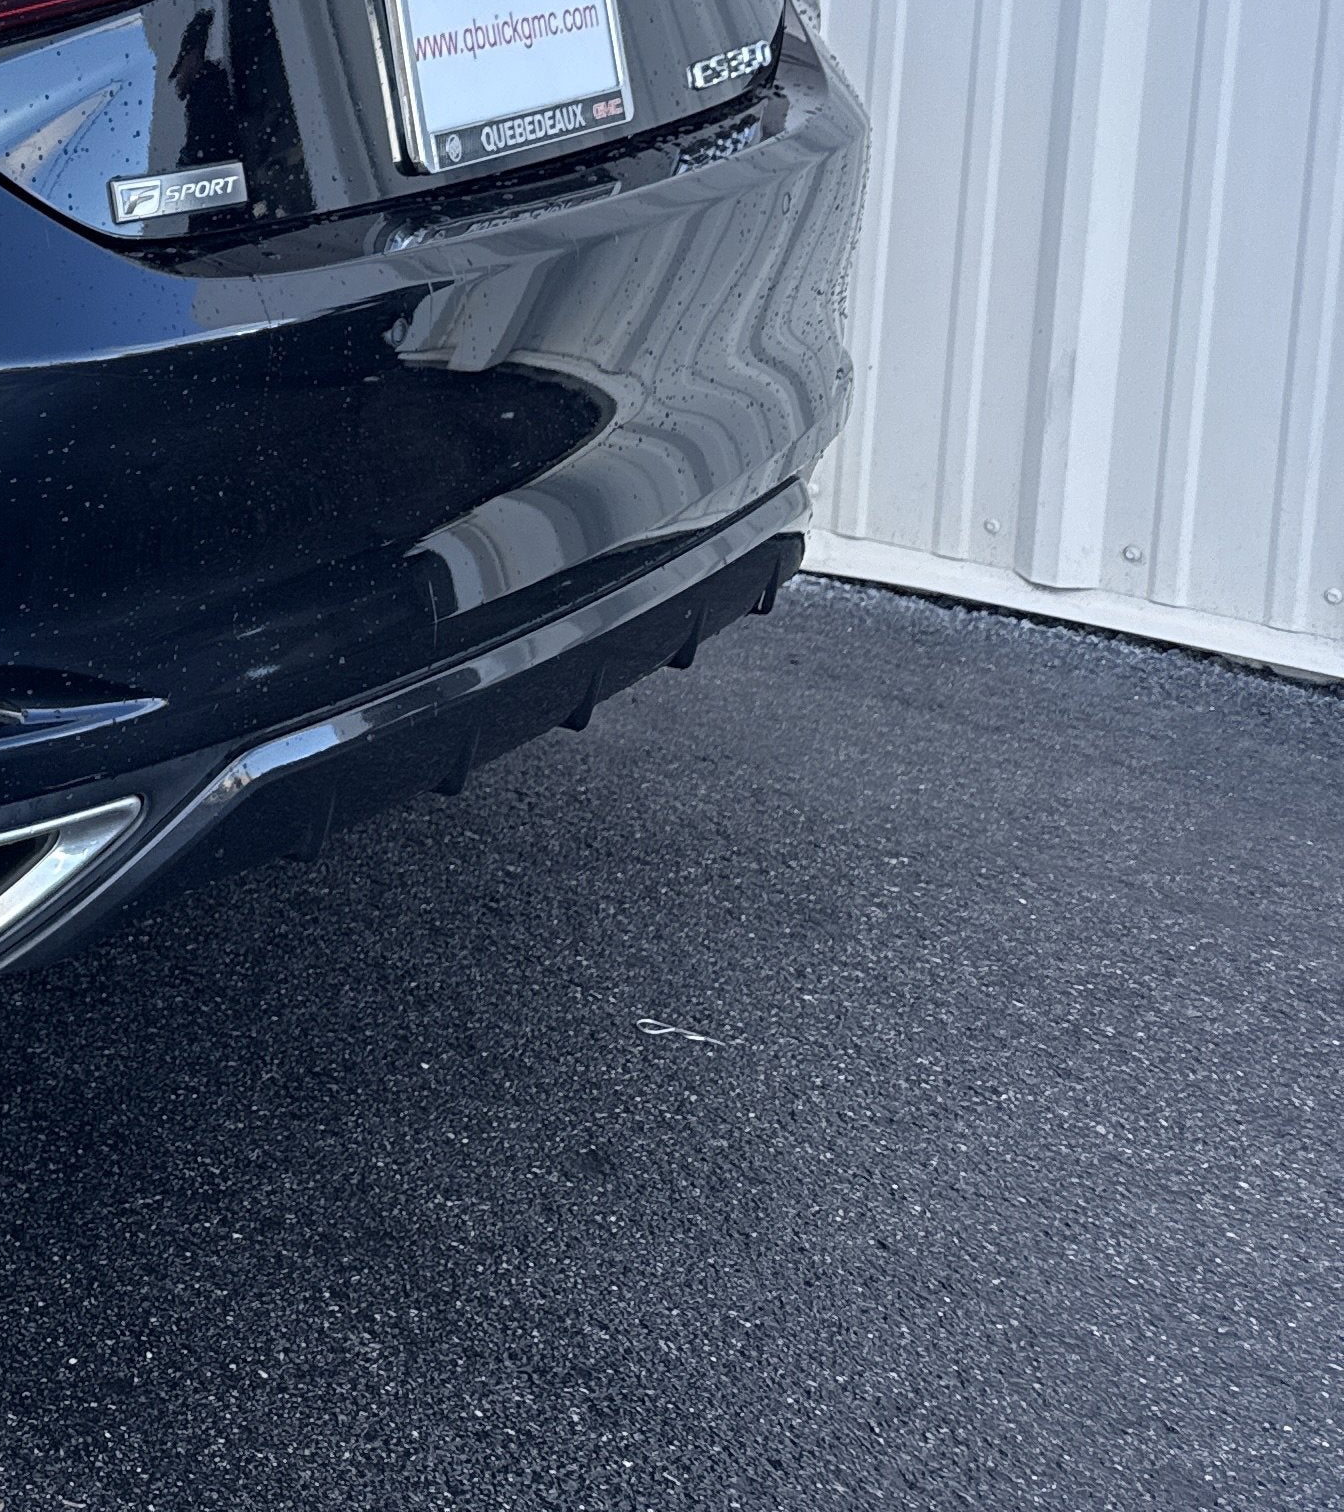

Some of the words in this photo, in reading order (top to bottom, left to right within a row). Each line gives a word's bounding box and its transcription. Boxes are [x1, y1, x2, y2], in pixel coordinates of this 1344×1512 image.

[413, 3, 601, 62] www.qbuickgmc.com
[480, 102, 587, 153] QUEBEDEAUX
[592, 97, 623, 120] GMC
[165, 175, 240, 203] SPORT
